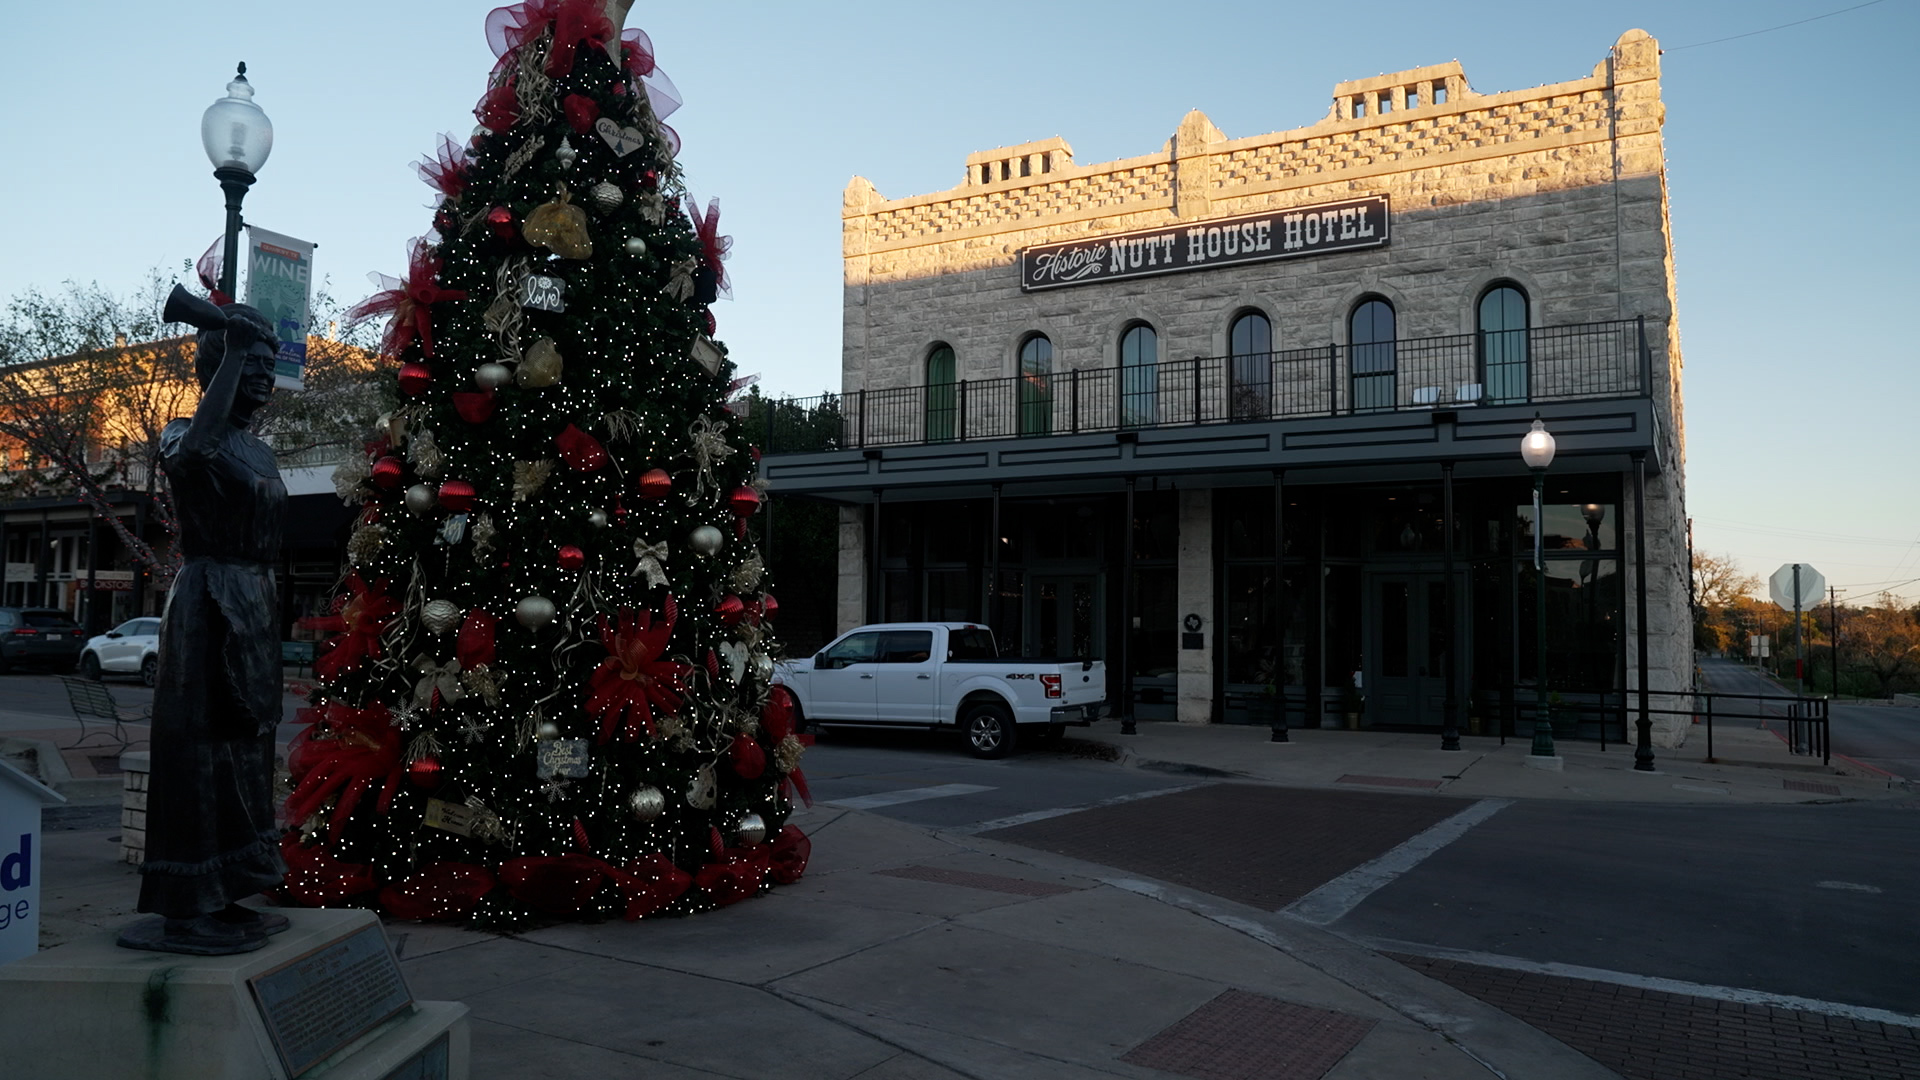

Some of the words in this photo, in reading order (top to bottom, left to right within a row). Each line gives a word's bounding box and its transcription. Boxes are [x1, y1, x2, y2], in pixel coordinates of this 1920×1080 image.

[1032, 243, 1107, 281] Historic
[1109, 233, 1176, 274] NUTT
[1186, 219, 1271, 264] HOUSE
[1283, 206, 1374, 251] HOTEL
[252, 254, 307, 284] WINE
[523, 275, 561, 310] love
[80, 580, 134, 590] BOKSTORE
